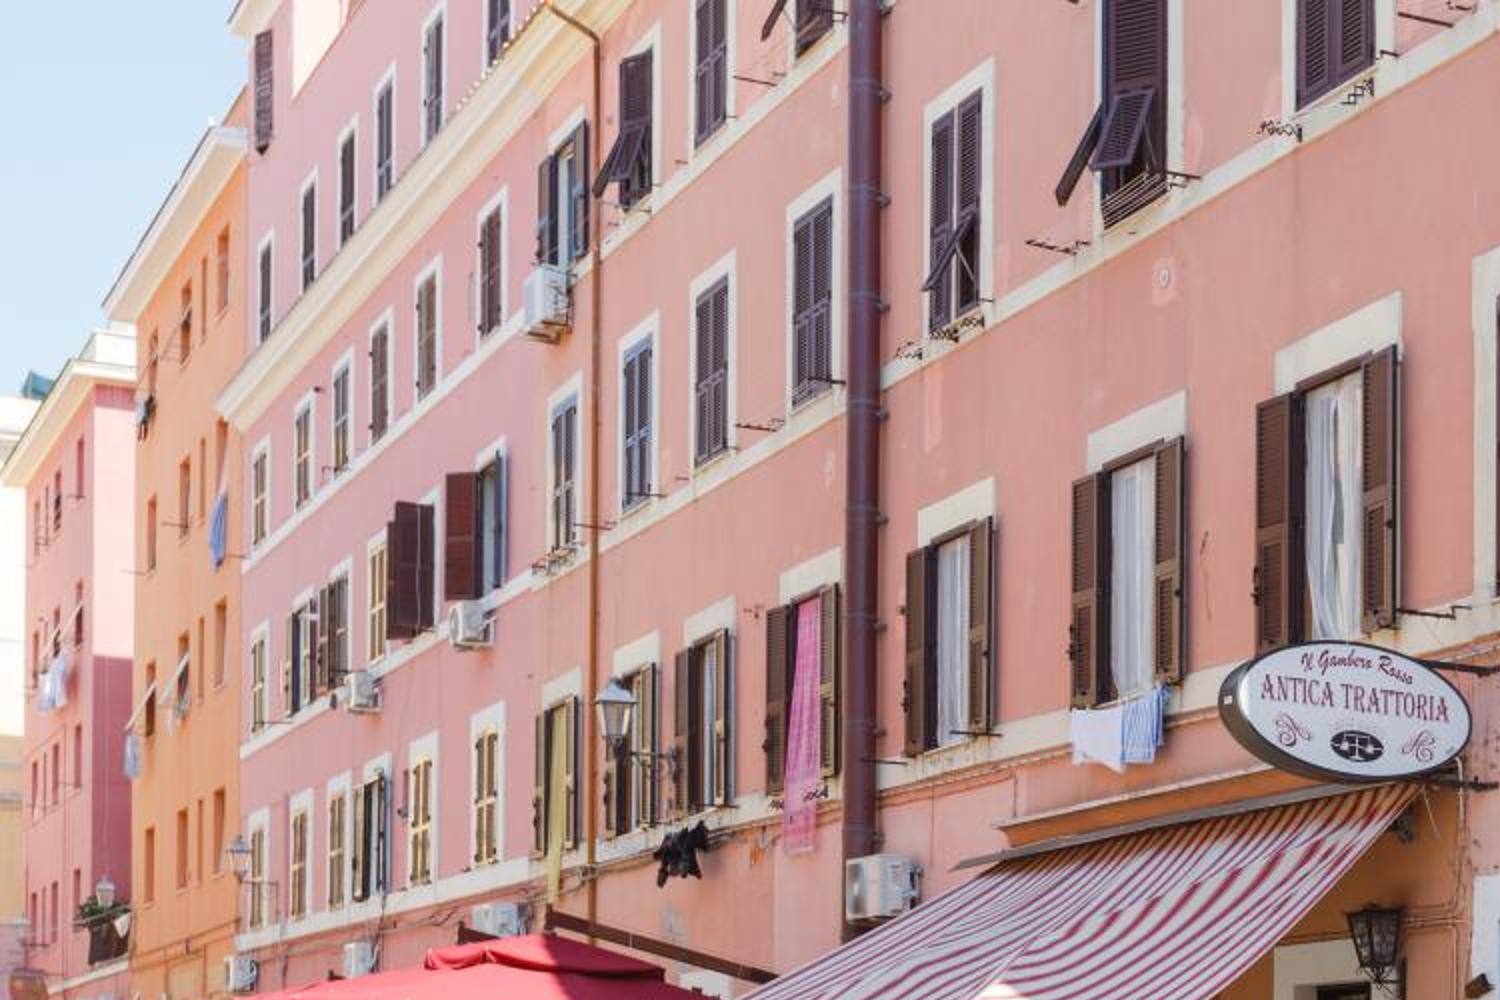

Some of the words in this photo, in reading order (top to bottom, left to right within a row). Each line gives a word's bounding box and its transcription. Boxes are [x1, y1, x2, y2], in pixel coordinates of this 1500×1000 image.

[1317, 650, 1373, 675] Gambero
[1377, 655, 1414, 685] Rosso
[1260, 673, 1335, 707] ANTICA
[1340, 683, 1450, 722] TRATTORIA
